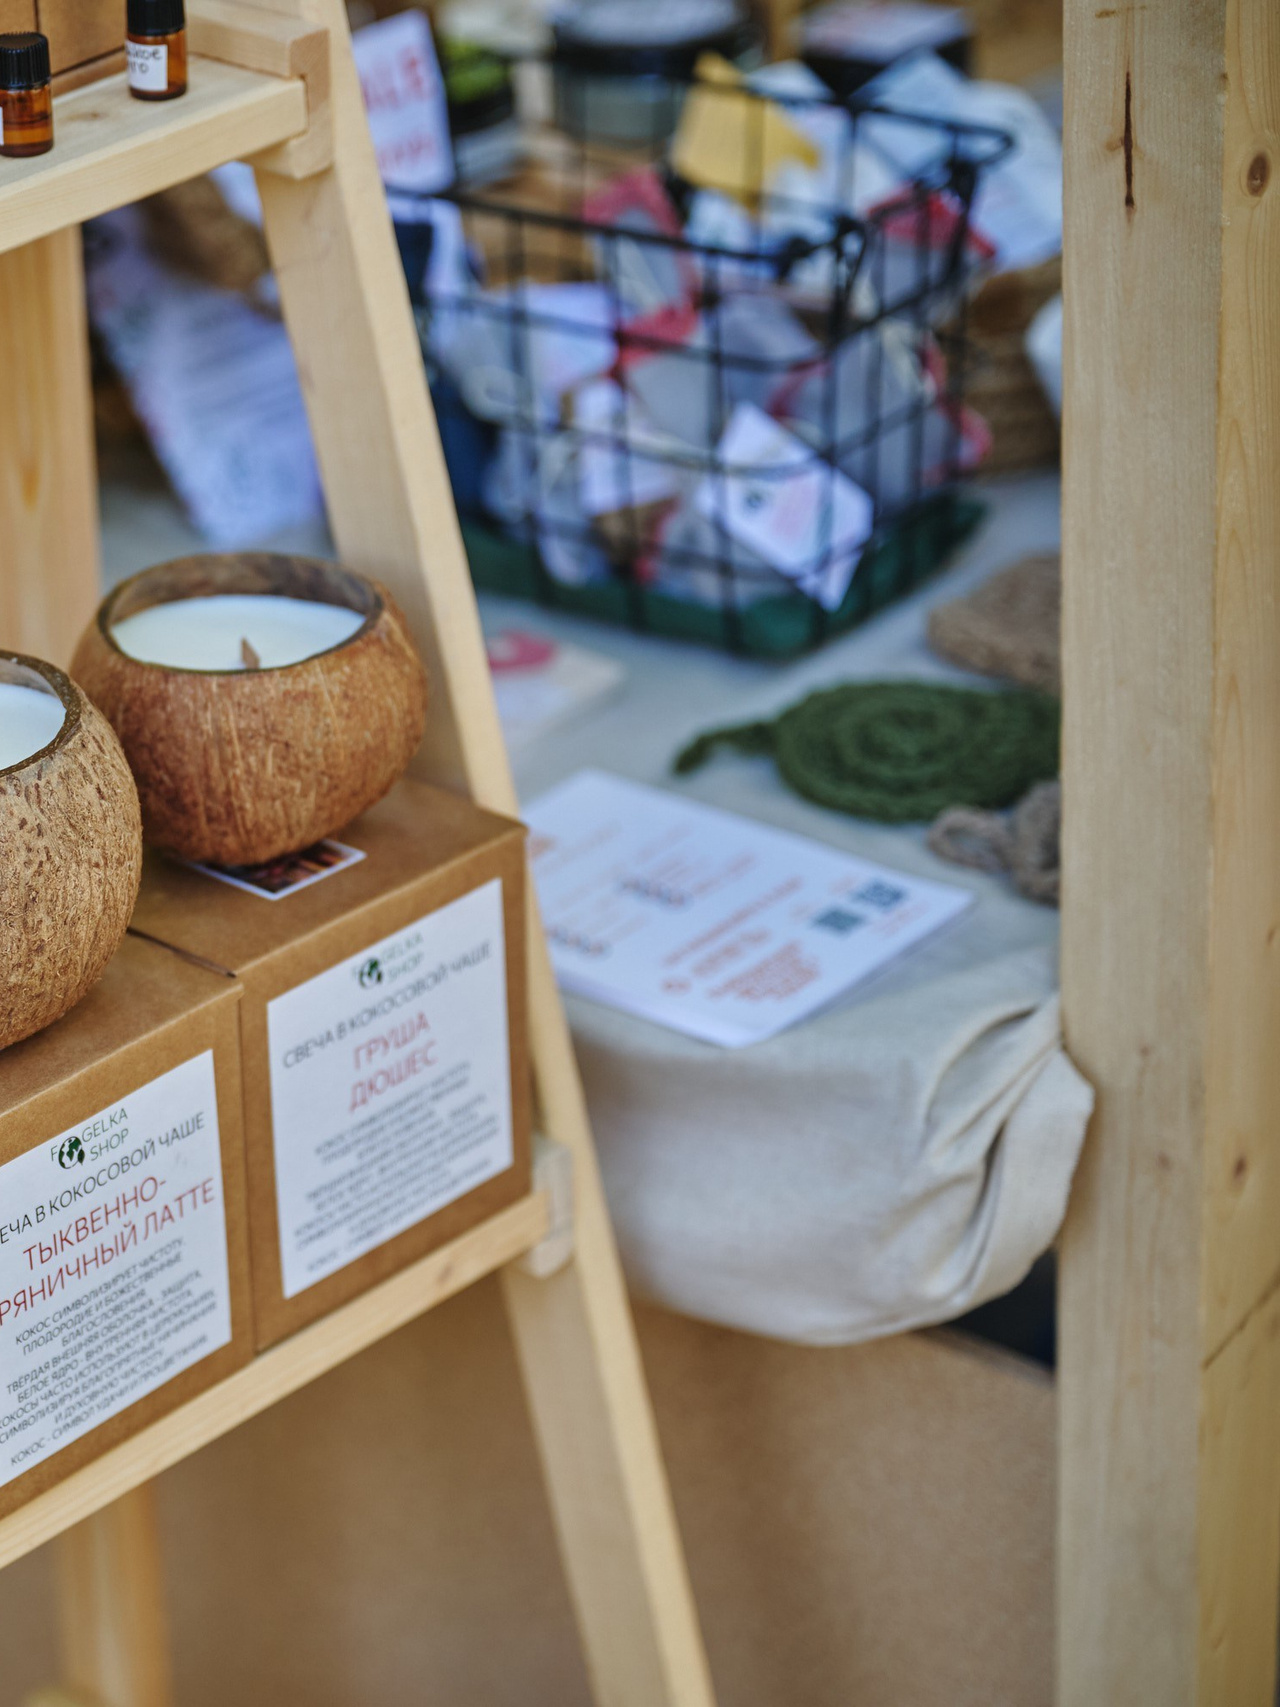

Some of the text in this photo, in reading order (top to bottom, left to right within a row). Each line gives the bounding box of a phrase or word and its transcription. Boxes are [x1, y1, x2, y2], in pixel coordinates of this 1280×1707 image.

[282, 1029, 335, 1069] СВЕЧА
[336, 1021, 347, 1040] В
[348, 962, 447, 1032] КОКОСОВОЙ
[352, 1010, 431, 1070] ГРУША
[347, 1038, 436, 1113] ДЮШЕС
[34, 1204, 46, 1224] В
[47, 1137, 156, 1216] КОКОСОВОЙ
[157, 1111, 204, 1147] ЧАШЕ
[88, 1126, 129, 1162] SHOP
[22, 1175, 167, 1271] ТЫКВЕННО-
[142, 1177, 213, 1241] ЛАТТЕ
[14, 1316, 50, 1345] КОКОС
[51, 1263, 137, 1324] СИМВОЛИЗИРУЕТ
[21, 1306, 92, 1356] ПЛОДОРОДИЕ
[5, 1360, 50, 1395] ТВЁРДАЯ
[50, 1330, 100, 1368] ВНЕШНЯЯ
[16, 1376, 48, 1404] БЕЛОЕ
[50, 1358, 79, 1381] ЯДРО
[38, 1375, 73, 1401] ЧАСТО
